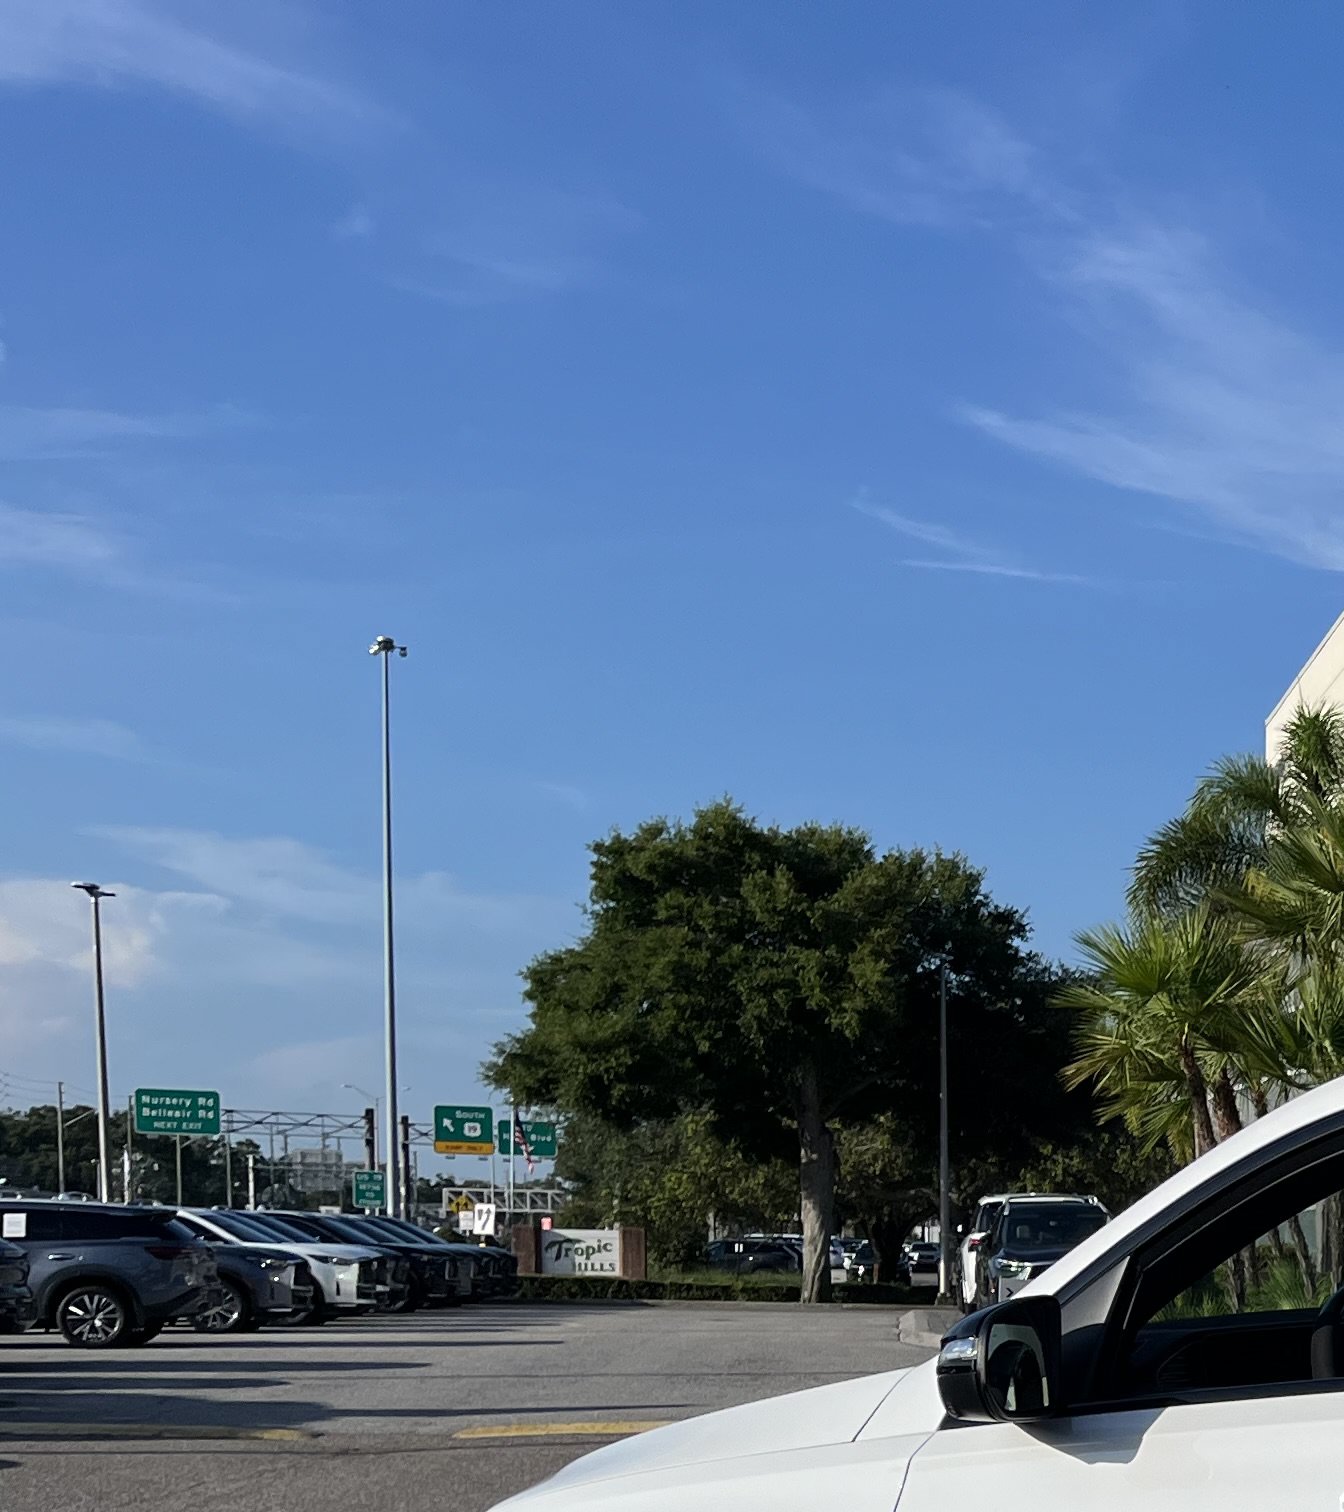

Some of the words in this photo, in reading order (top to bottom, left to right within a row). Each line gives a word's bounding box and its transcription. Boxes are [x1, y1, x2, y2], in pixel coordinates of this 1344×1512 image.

[141, 1095, 192, 1107] Nursery
[198, 1097, 214, 1107] Rd
[198, 1109, 214, 1119] Rd
[544, 1239, 613, 1262] Tropic
